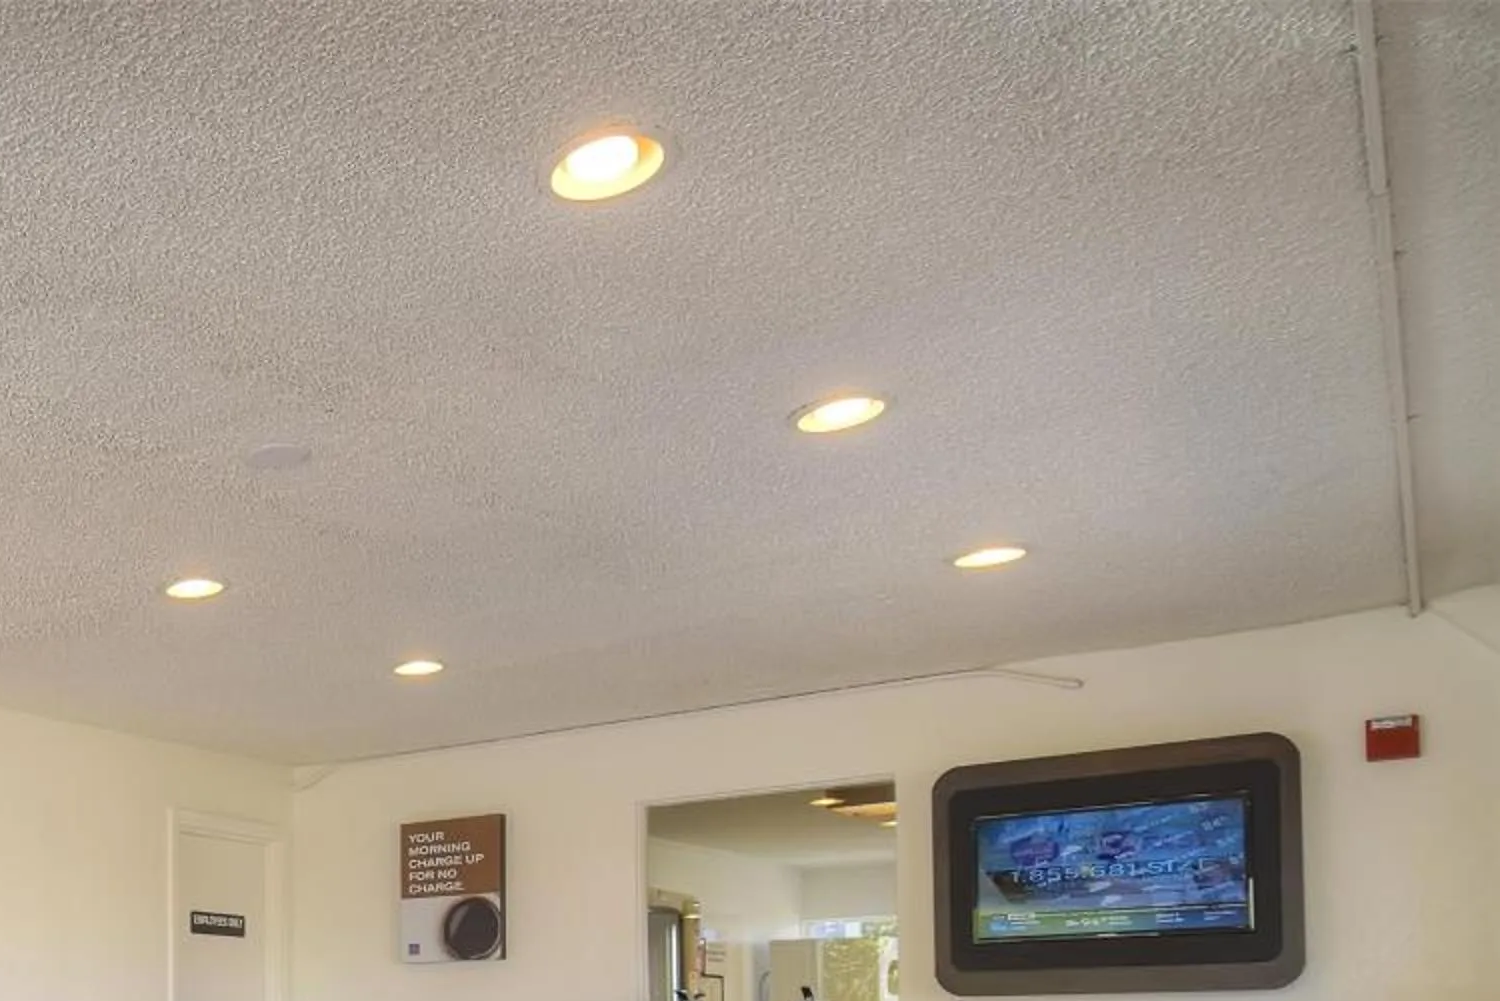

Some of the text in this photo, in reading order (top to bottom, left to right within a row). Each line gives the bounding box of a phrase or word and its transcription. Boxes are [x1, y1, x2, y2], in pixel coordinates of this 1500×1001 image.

[408, 831, 445, 844] YOUR
[408, 841, 471, 857] MORNING
[408, 853, 485, 869] CHARGE UP
[408, 868, 458, 882] FOR NO
[408, 881, 465, 894] CHARGE
